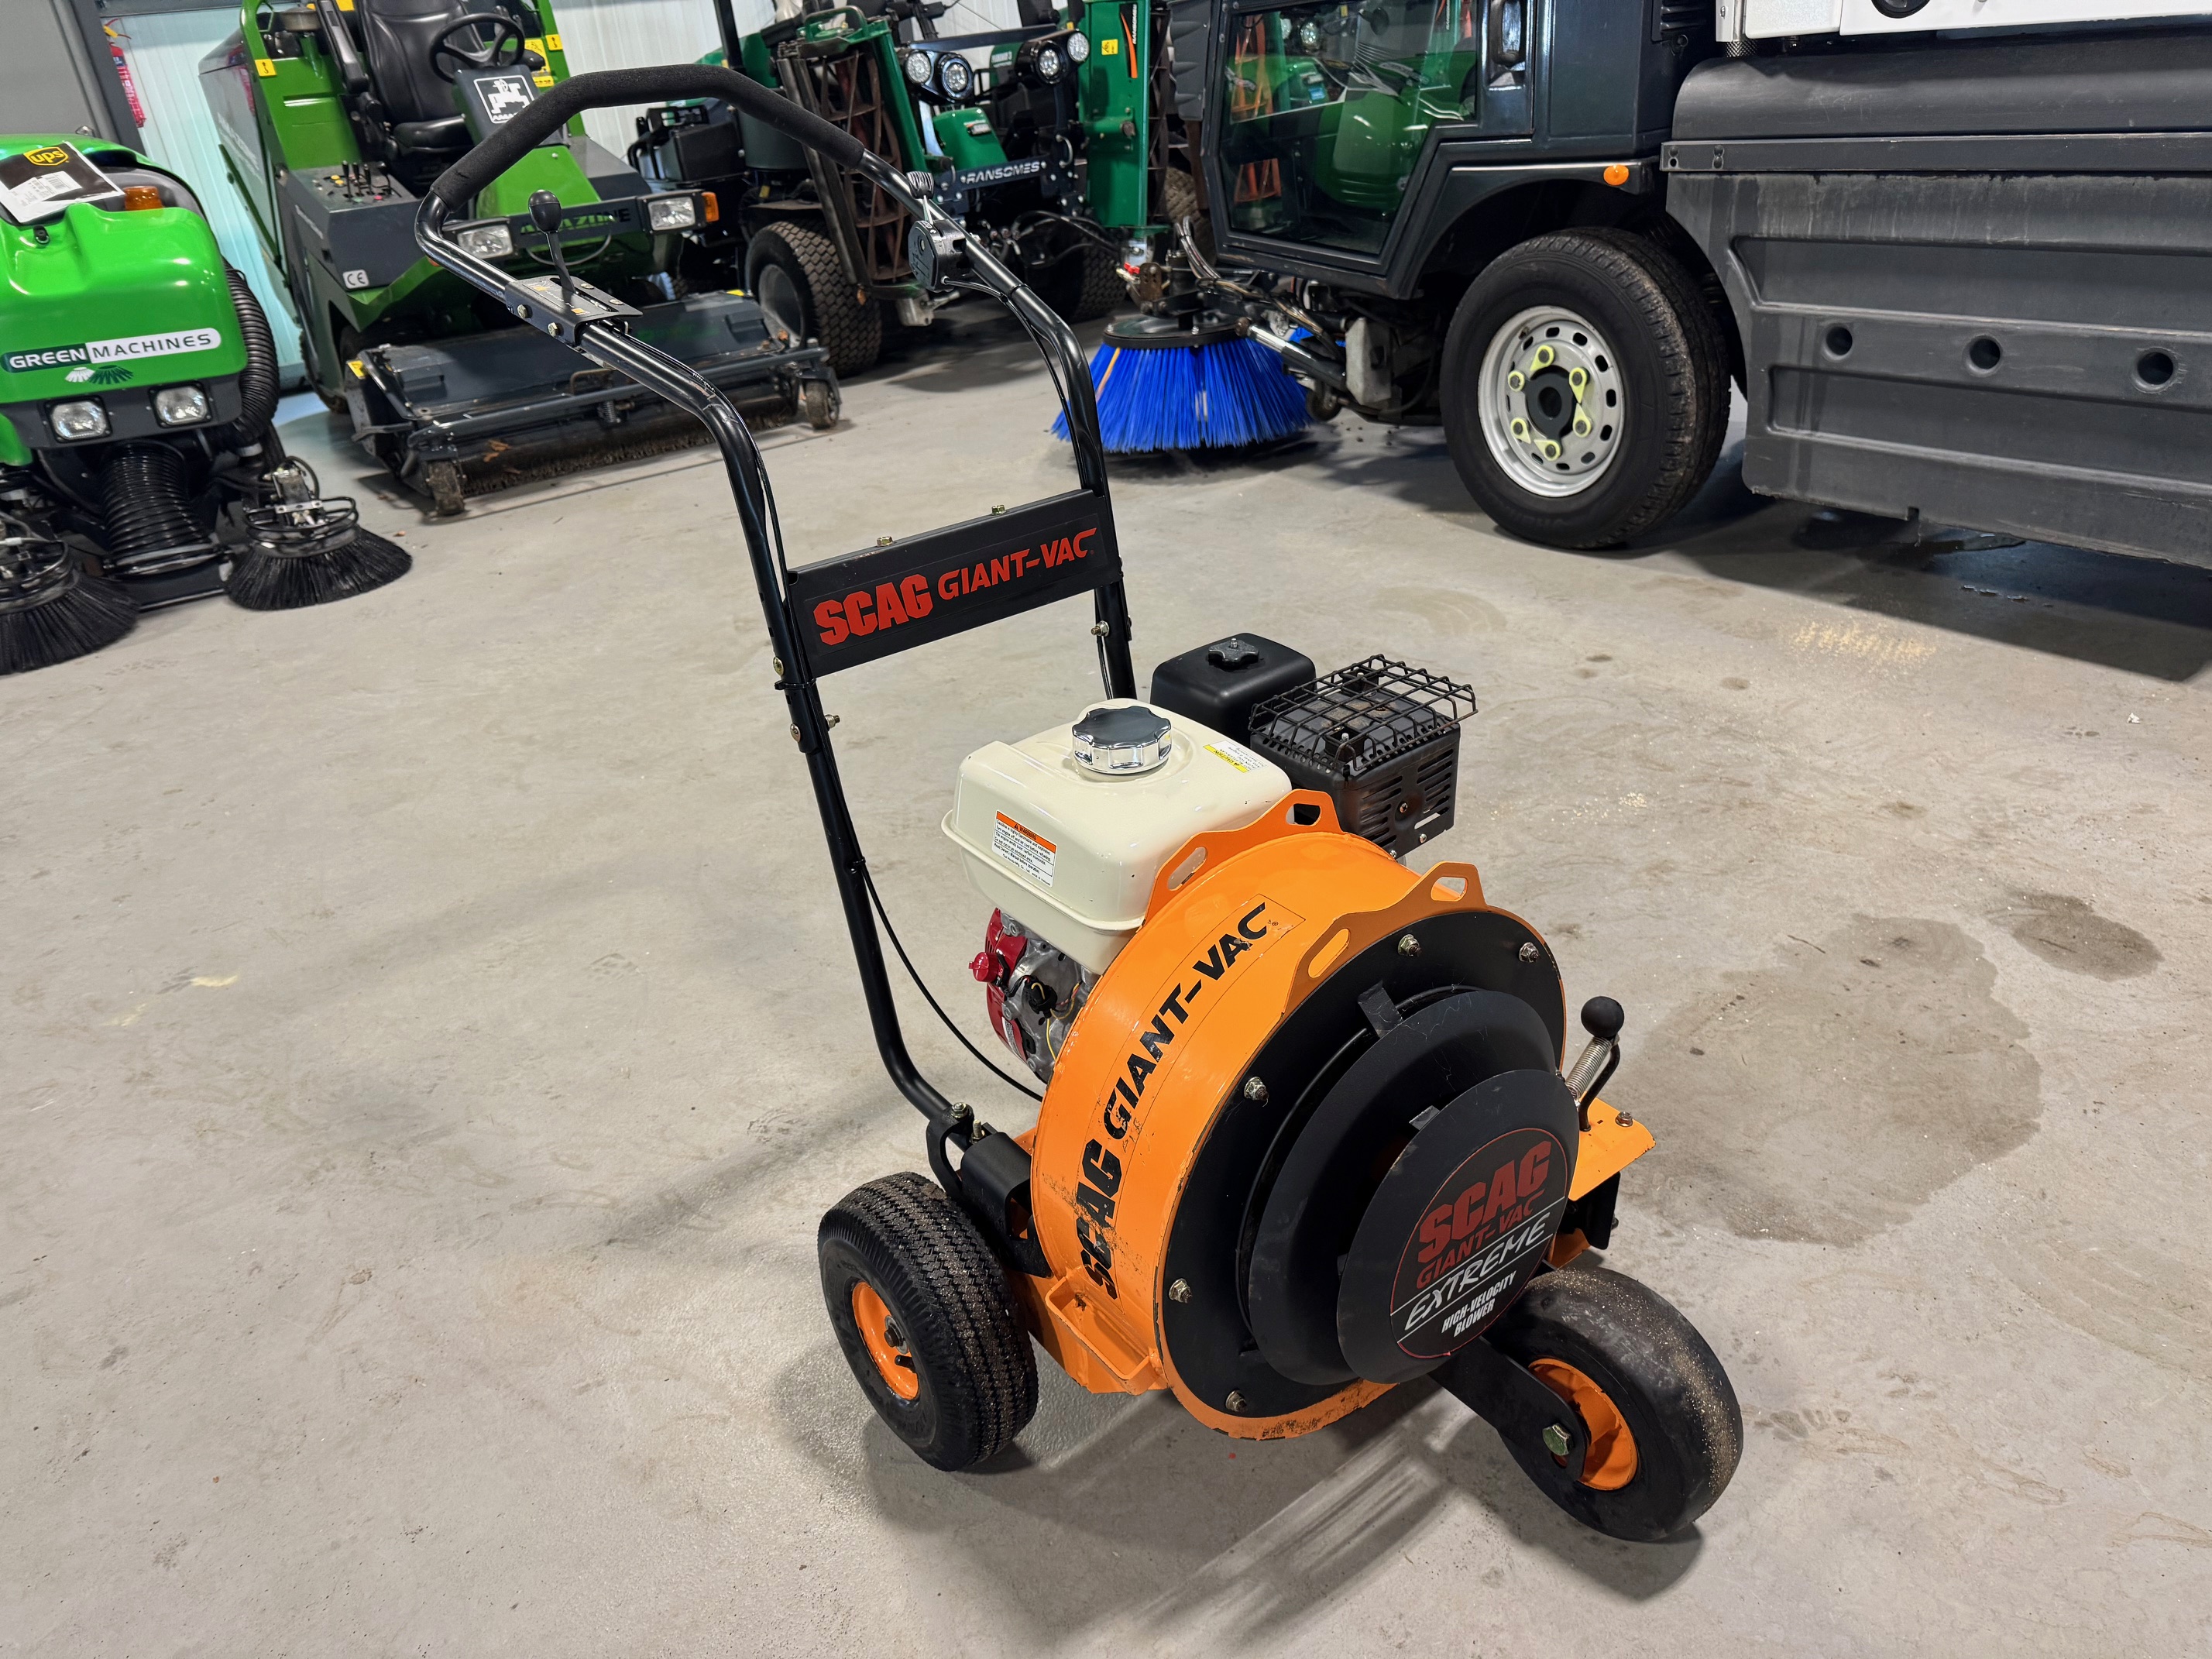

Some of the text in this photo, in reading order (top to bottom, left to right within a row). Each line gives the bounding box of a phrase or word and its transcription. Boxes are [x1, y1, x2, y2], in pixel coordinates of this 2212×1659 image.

[30, 150, 64, 163] ups
[966, 161, 1040, 184] RANSOMES
[9, 333, 211, 369] GREEN MACHINES
[813, 527, 1097, 645] SCAG GIANT-VAC
[1019, 826, 1036, 840] WARNING
[1076, 902, 1265, 1300] SCAG GIANT-VAC
[1418, 1141, 1551, 1263] SCAG
[1405, 1212, 1551, 1331] EXTREME
[1441, 1270, 1516, 1333] HIGH-VELOCITY
[1454, 1298, 1496, 1338] BLOWER
